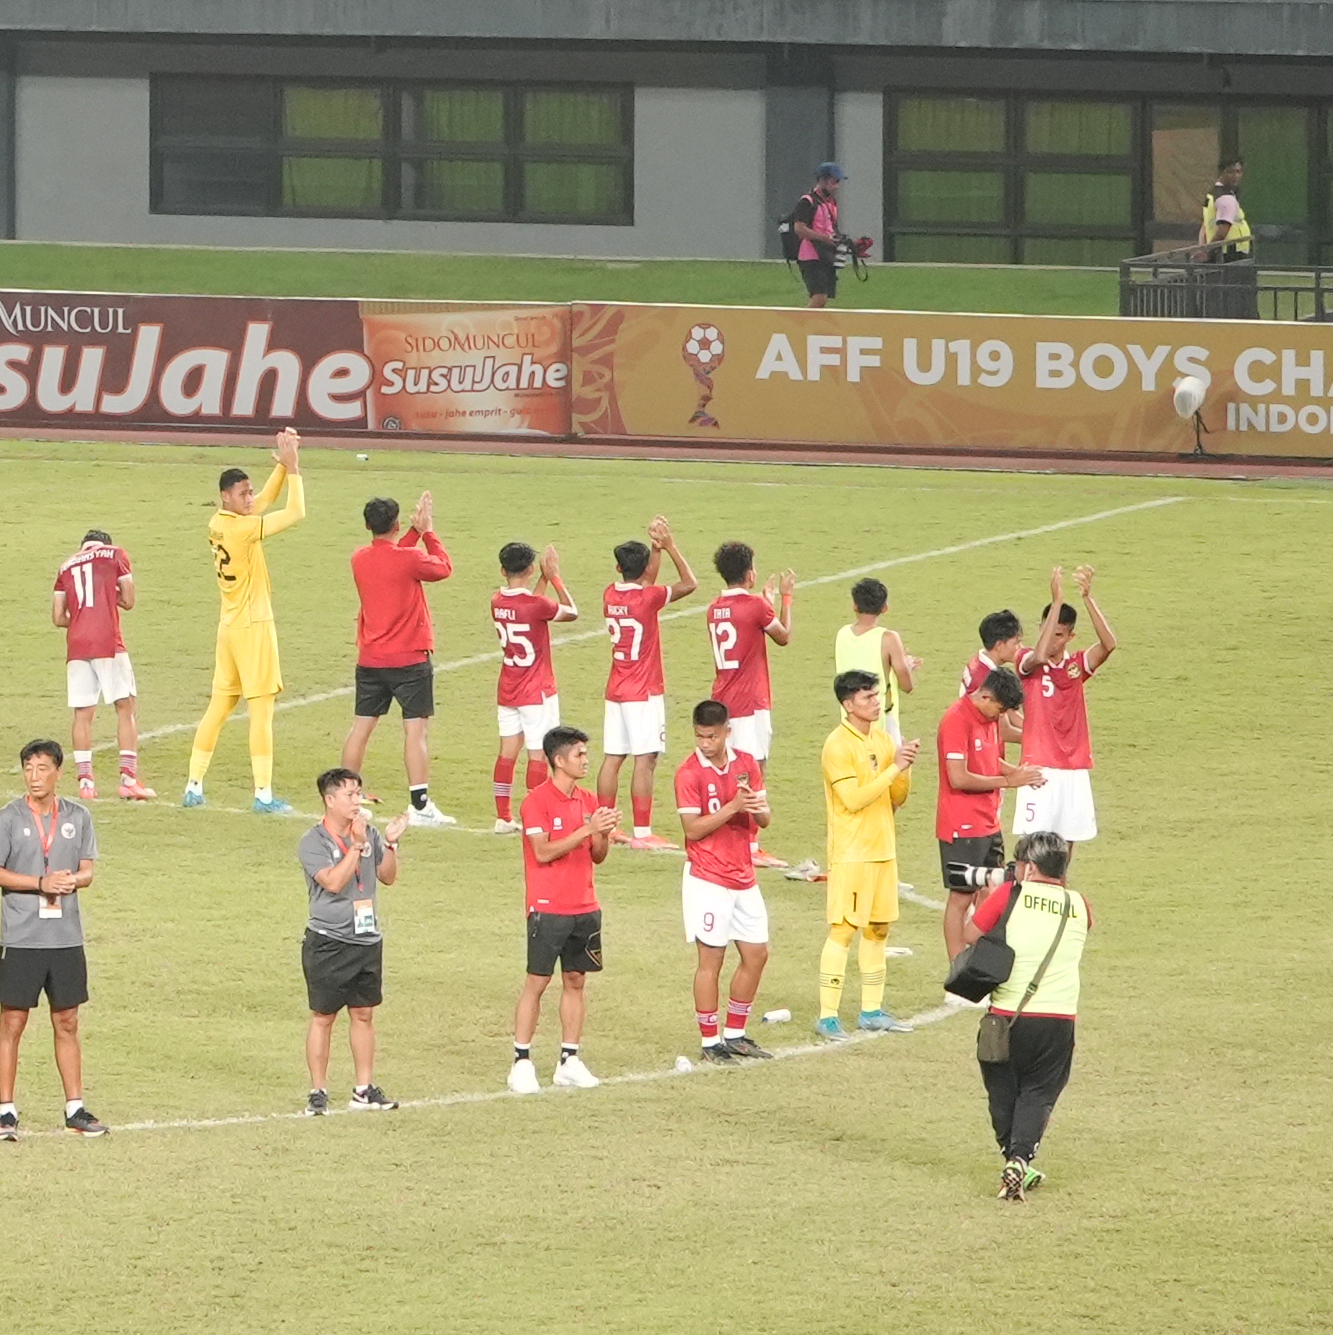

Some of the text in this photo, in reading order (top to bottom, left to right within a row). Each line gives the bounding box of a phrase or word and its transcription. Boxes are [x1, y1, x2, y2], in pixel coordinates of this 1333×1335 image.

[755, 332, 1333, 398] AFF U19 BOYS CH
[1226, 402, 1333, 435] INDO
[70, 562, 94, 610] 11
[493, 621, 537, 667] 25
[605, 617, 644, 661] 27
[709, 621, 740, 670] 12
[1041, 675, 1055, 697] 5
[1025, 802, 1036, 822] 5
[852, 891, 858, 913] 1
[1024, 894, 1078, 918] OFFICIL
[703, 912, 715, 932] 9
